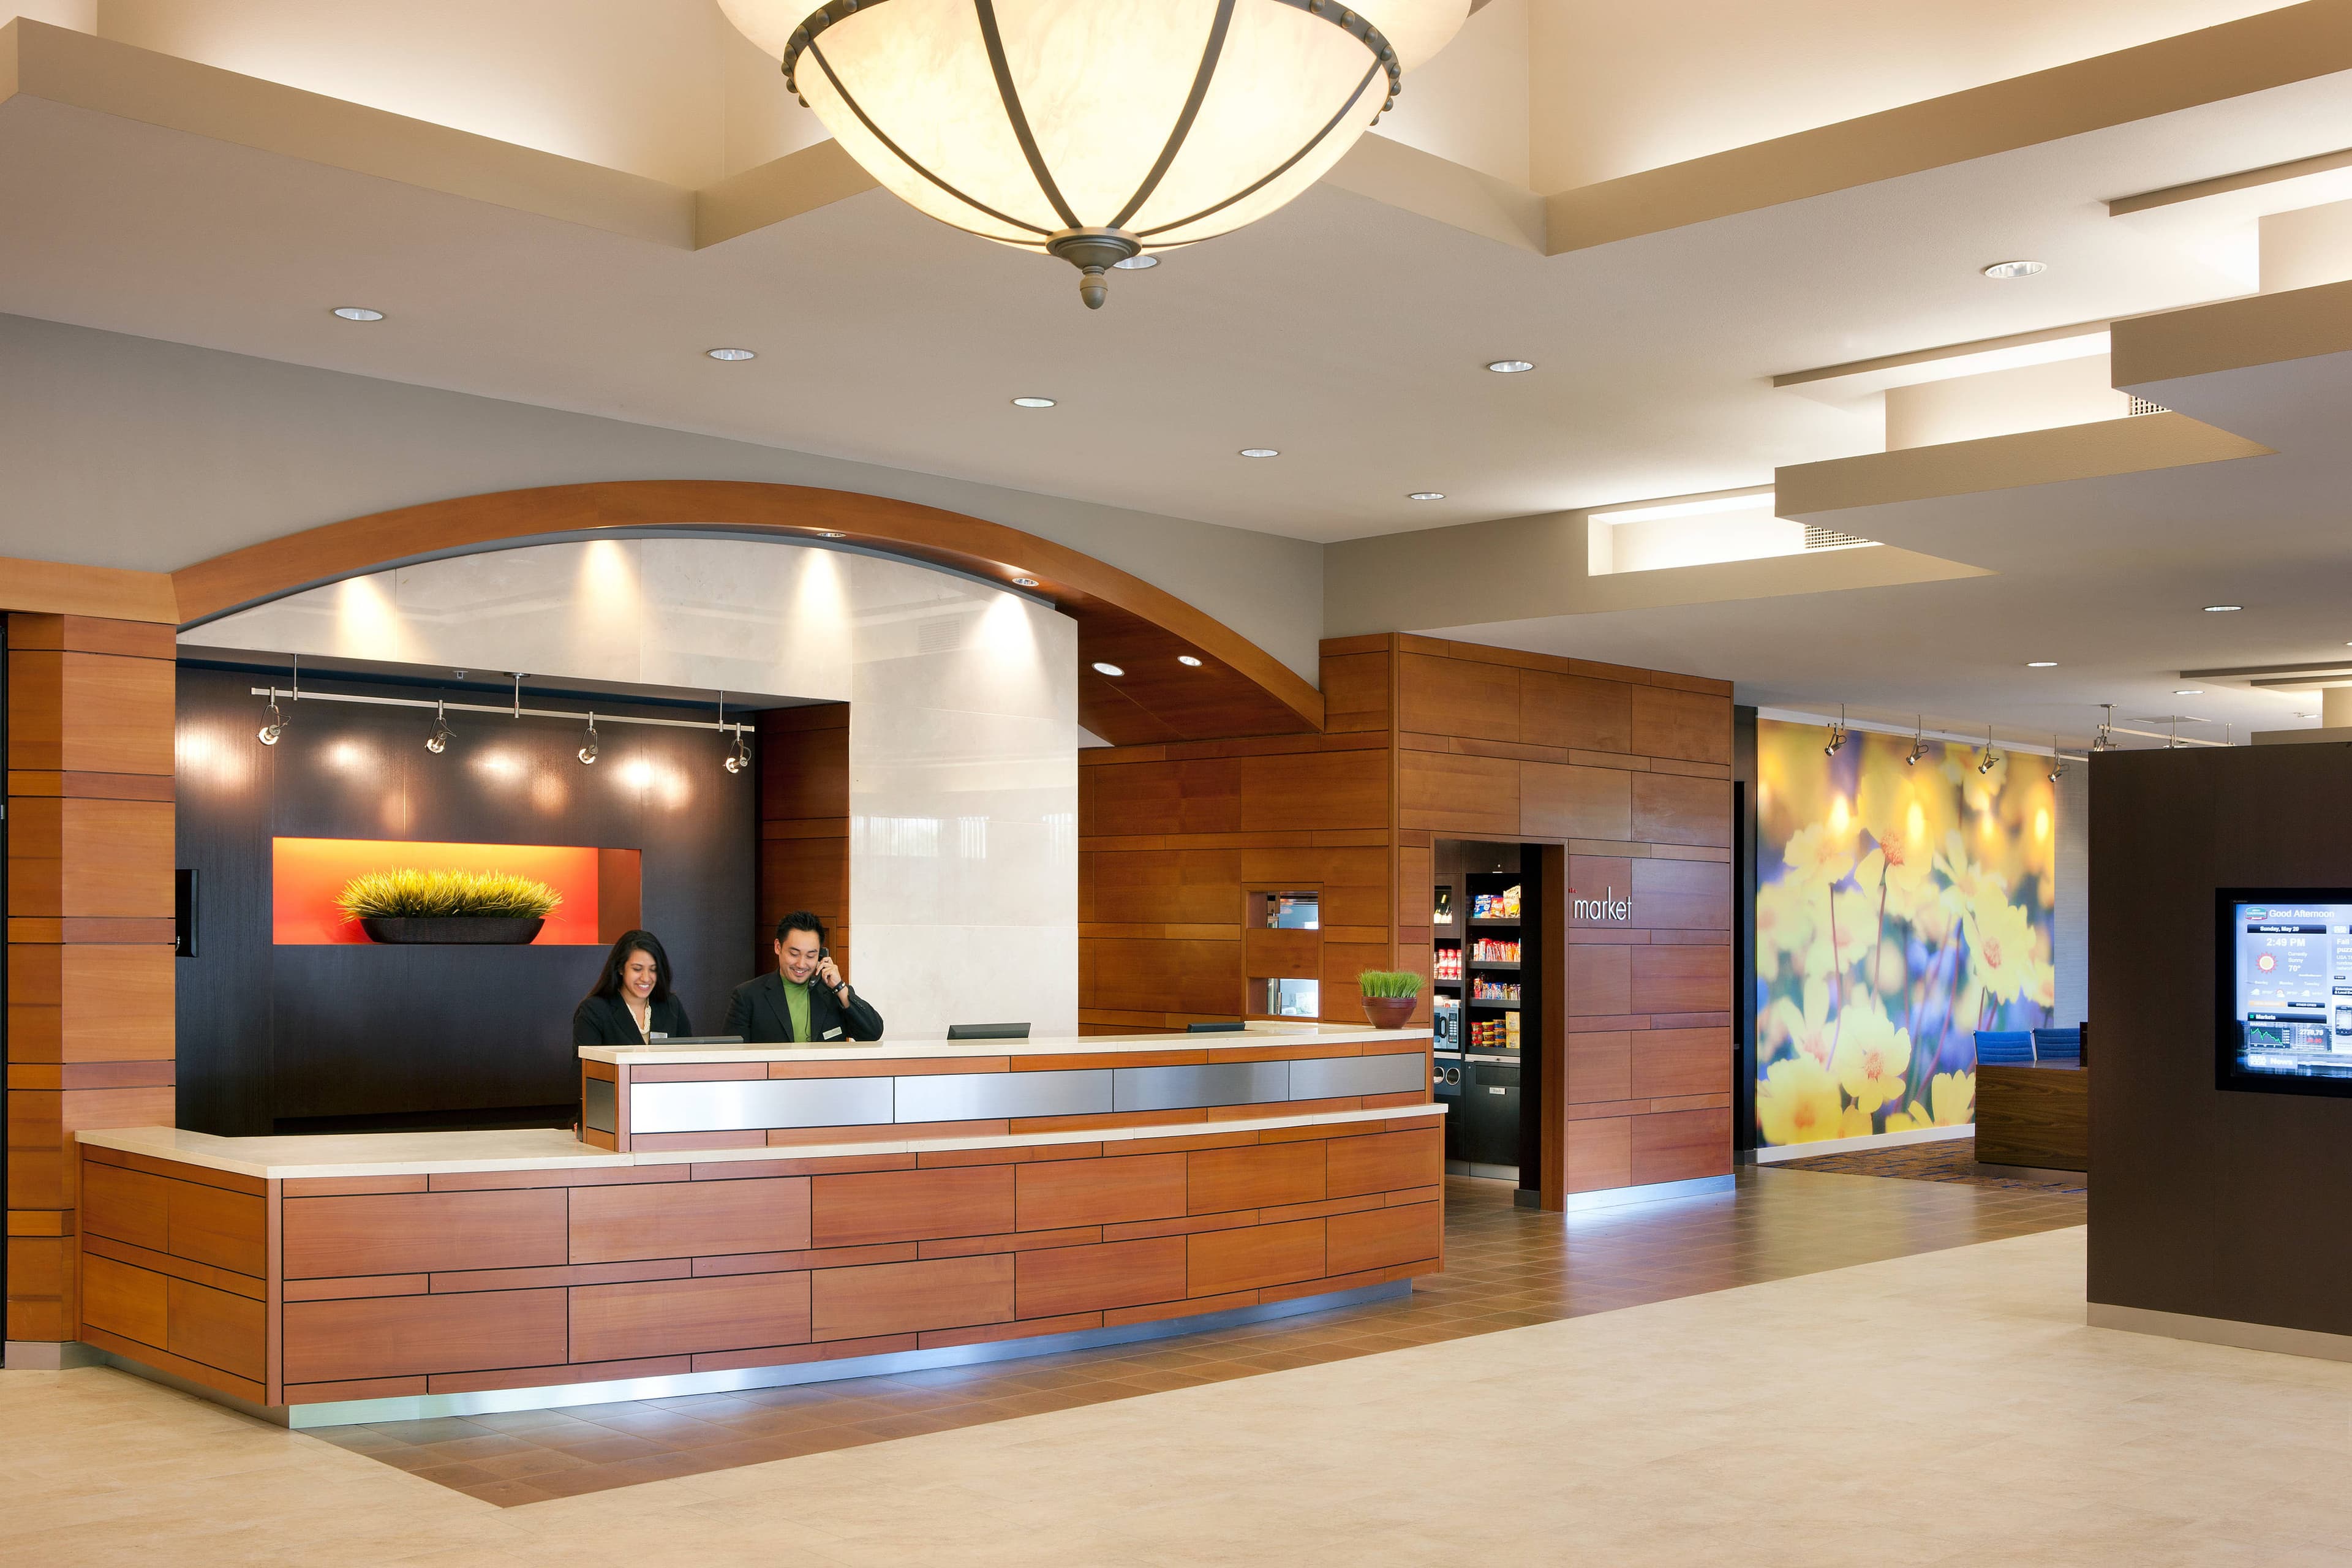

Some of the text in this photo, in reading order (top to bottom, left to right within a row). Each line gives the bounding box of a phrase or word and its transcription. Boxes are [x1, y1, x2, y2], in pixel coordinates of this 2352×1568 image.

[1574, 886, 1632, 921] market
[2269, 910, 2291, 918] Good
[2293, 909, 2335, 918] Afternoon
[2266, 938, 2305, 947] 2:49 PM
